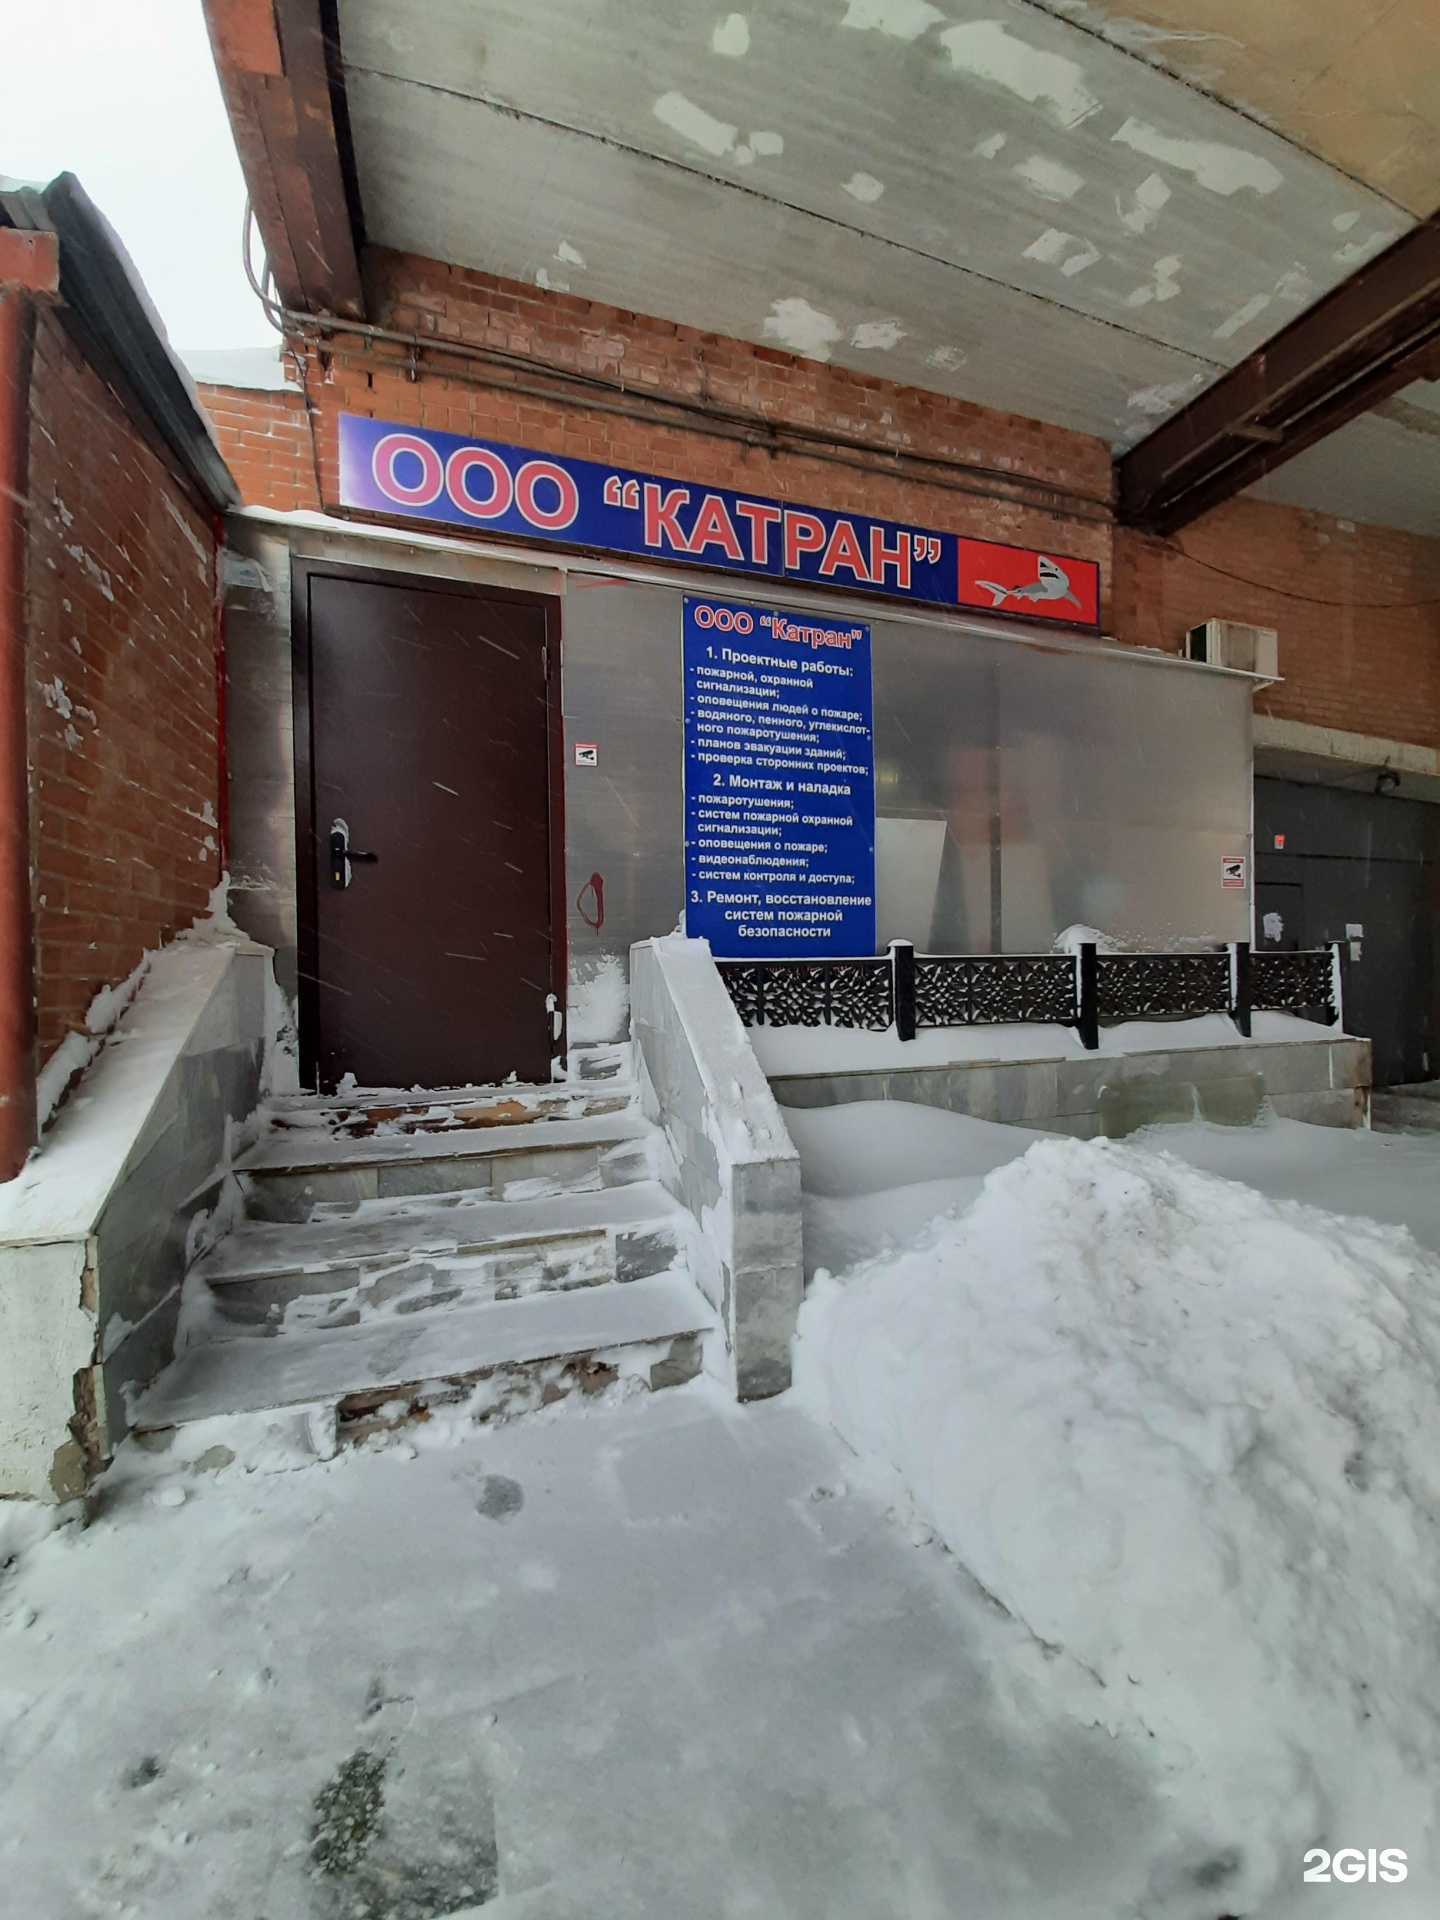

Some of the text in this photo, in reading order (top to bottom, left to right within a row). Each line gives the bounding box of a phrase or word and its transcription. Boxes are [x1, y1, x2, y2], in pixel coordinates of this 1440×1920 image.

[371, 433, 579, 531] ООО
[695, 605, 753, 634] ООО
[706, 647, 717, 659] 1.
[722, 648, 798, 670] Проектные
[697, 666, 757, 682] пожарной,
[761, 675, 813, 688] охранной
[697, 680, 779, 699] сигнализации;
[698, 695, 769, 710] оповещения
[773, 703, 808, 715] людей
[821, 709, 862, 721] пожаре;
[698, 710, 755, 724] водяного,
[758, 716, 806, 729] пенного,
[809, 721, 870, 734] углекислот-
[698, 724, 819, 743] ного пожаротушения;
[698, 738, 741, 750] планов
[744, 742, 801, 755] эвакуации
[804, 748, 846, 759] зданий;
[698, 752, 753, 766] проверка
[756, 757, 814, 770] сторонних
[817, 762, 869, 776] проектов;
[713, 774, 725, 786] 2.
[729, 775, 783, 790] Монтаж
[798, 783, 850, 796] наладка
[699, 794, 794, 809] пожаротушения;
[699, 810, 740, 819] систем
[744, 812, 799, 824] пожарной
[802, 816, 853, 827] охранной
[698, 824, 782, 837] сигнализации;
[699, 840, 770, 850] оповещения
[784, 843, 827, 854] пожаре;
[699, 854, 809, 868] видеонаблюдения;
[699, 871, 740, 880] систем
[744, 873, 796, 883] контроля
[809, 874, 855, 884] доступа;
[691, 891, 871, 906] 3. Ремонт, восстановление
[725, 909, 843, 923] систем пожарной
[738, 925, 831, 937] безопасности
